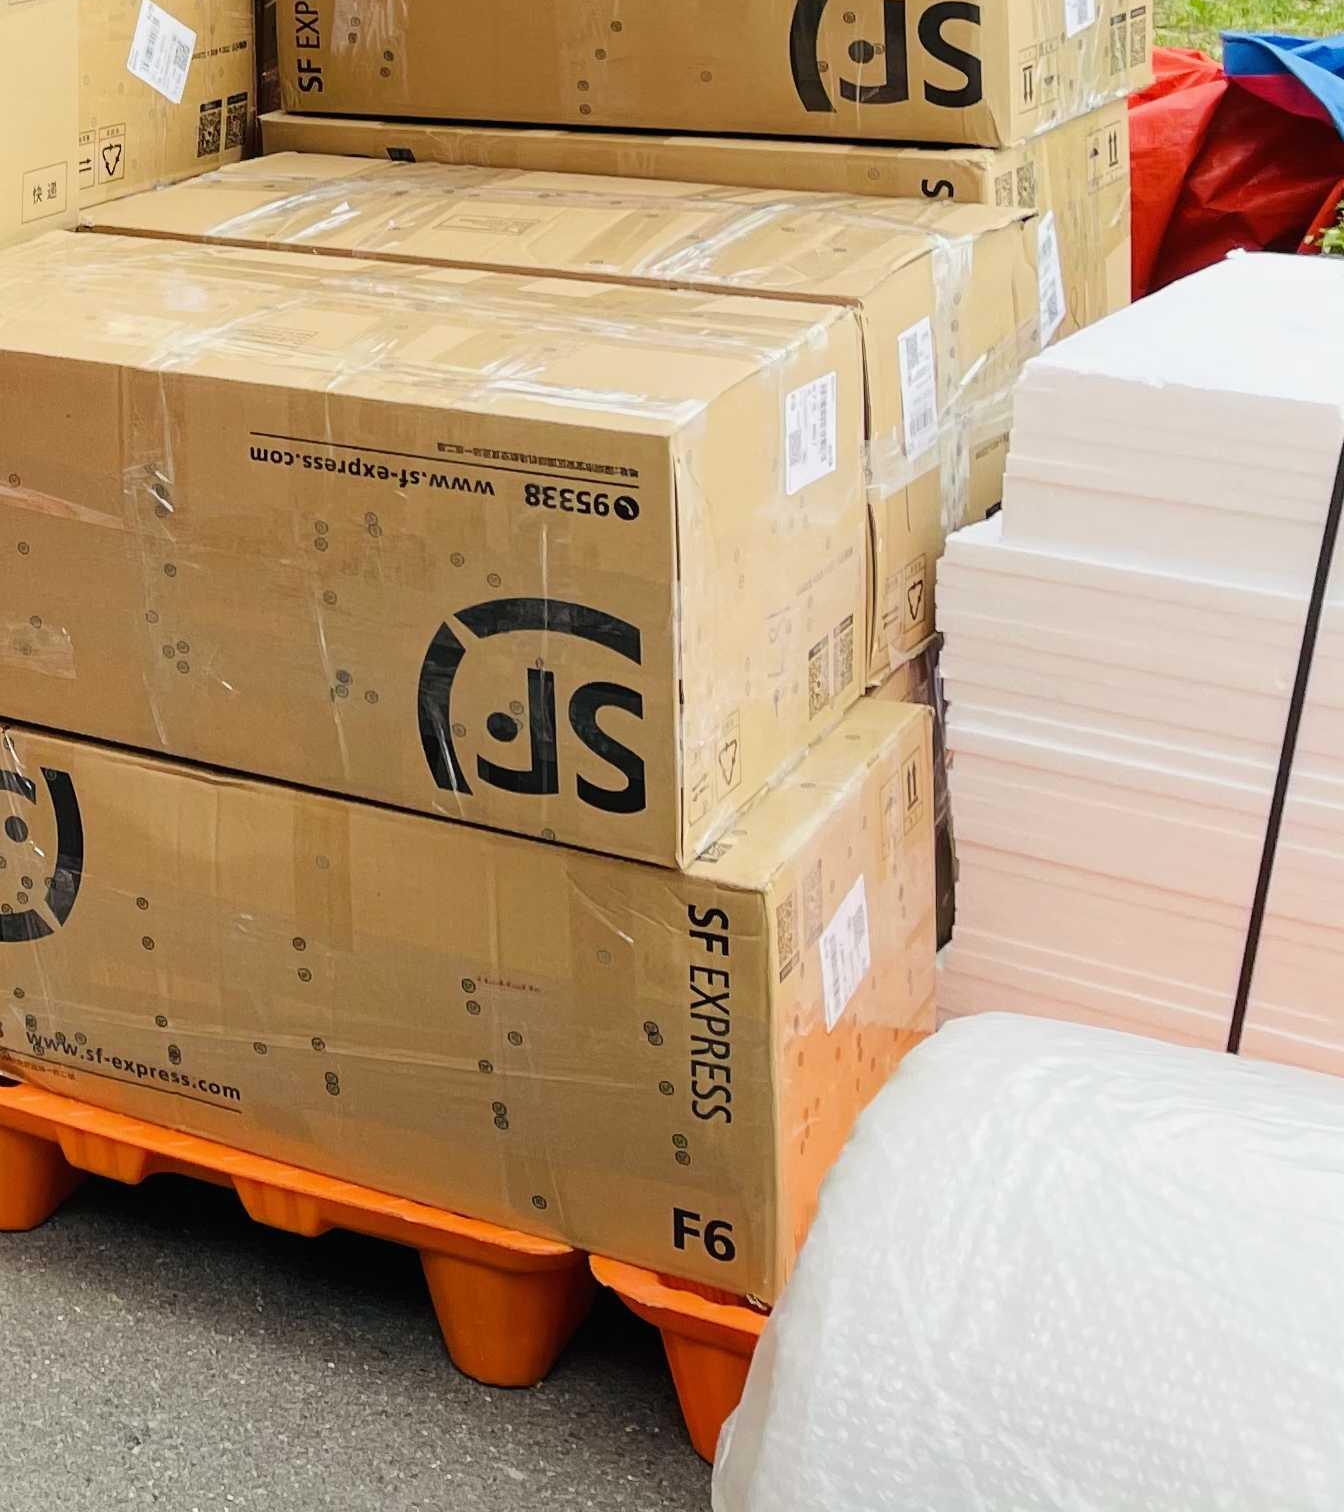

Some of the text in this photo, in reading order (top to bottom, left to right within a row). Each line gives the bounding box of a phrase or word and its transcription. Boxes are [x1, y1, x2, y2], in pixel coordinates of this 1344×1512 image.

[299, 57, 324, 93] SF
[839, 0, 982, 111] SF
[249, 445, 495, 497] www.sf-express.com
[524, 482, 610, 518] 95338
[477, 668, 646, 814] SF
[687, 904, 732, 1125] SF EXPRESS
[26, 1029, 242, 1103] www.sf-express.com
[672, 1207, 737, 1263] F6
